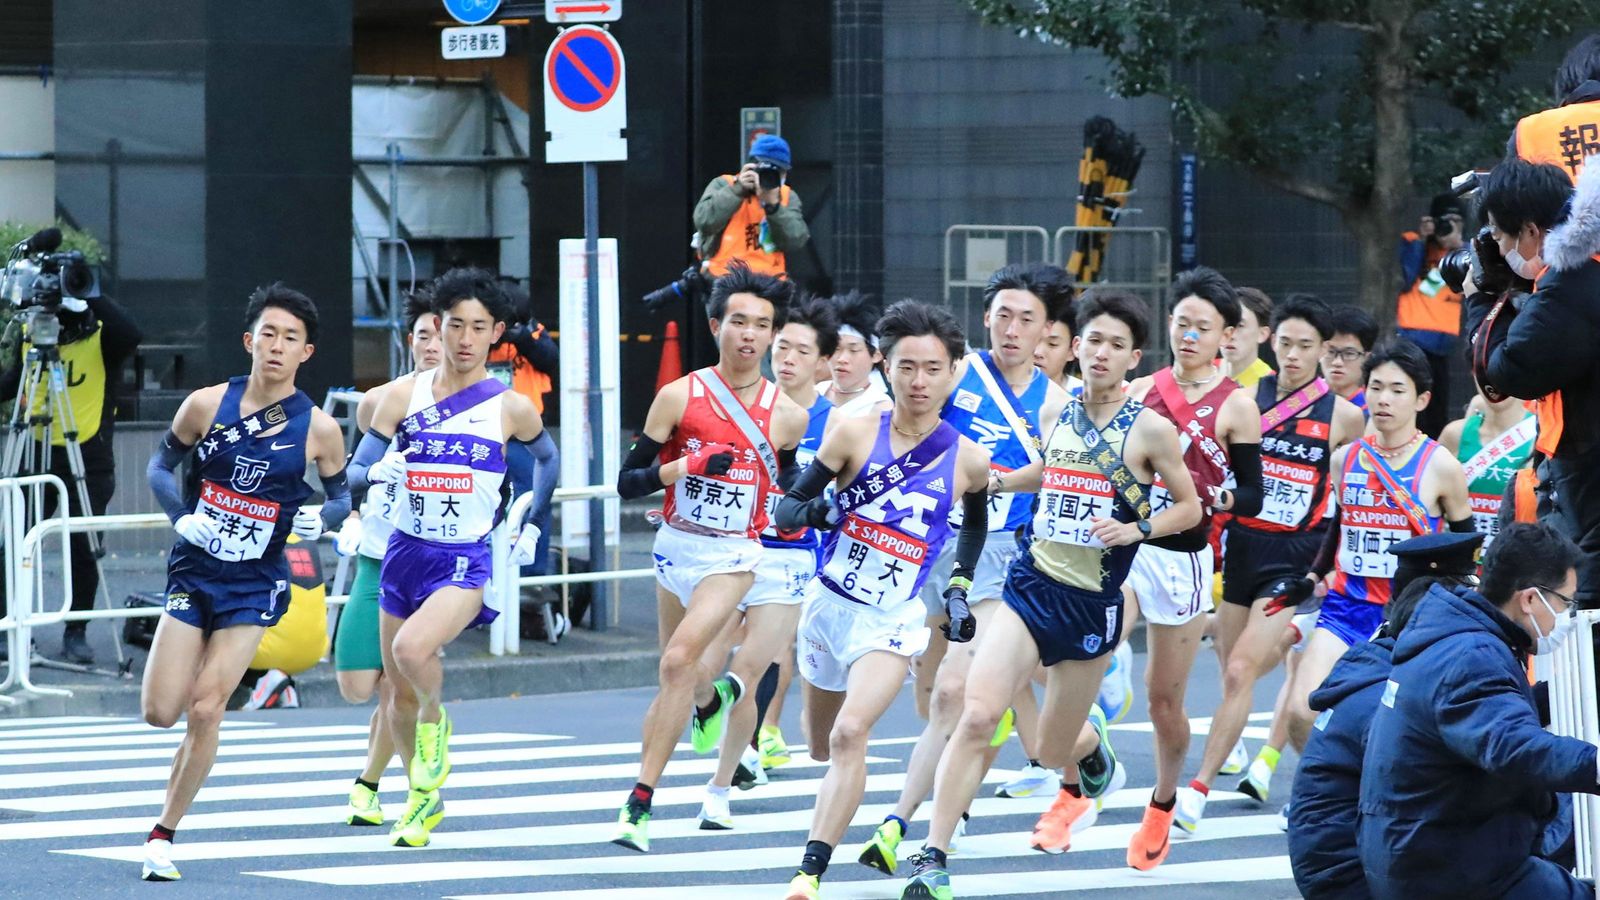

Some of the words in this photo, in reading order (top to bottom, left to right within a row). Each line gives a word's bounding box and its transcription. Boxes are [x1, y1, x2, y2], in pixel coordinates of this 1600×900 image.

[448, 33, 499, 52] 歩行者優先
[1260, 436, 1324, 462] 學院大學
[411, 475, 471, 490] SAPPORO
[1053, 473, 1111, 493] SAPPORO
[1262, 461, 1314, 482] SAPPORO
[685, 476, 745, 510] 帝京大
[839, 464, 905, 510] 明治大学
[1263, 477, 1309, 507] 學院大
[1342, 486, 1399, 509] 創価大
[215, 492, 276, 518] SAPPORO
[691, 505, 729, 528] 4-1
[1044, 492, 1101, 521] 東国大
[413, 518, 458, 537] 8-15
[1352, 511, 1408, 526] SAPPORO
[860, 525, 924, 560] SAPPORO
[1047, 519, 1091, 544] 5-15
[209, 537, 245, 562] 0-1
[1353, 556, 1388, 575] 9-1
[843, 571, 885, 605] 6-1
